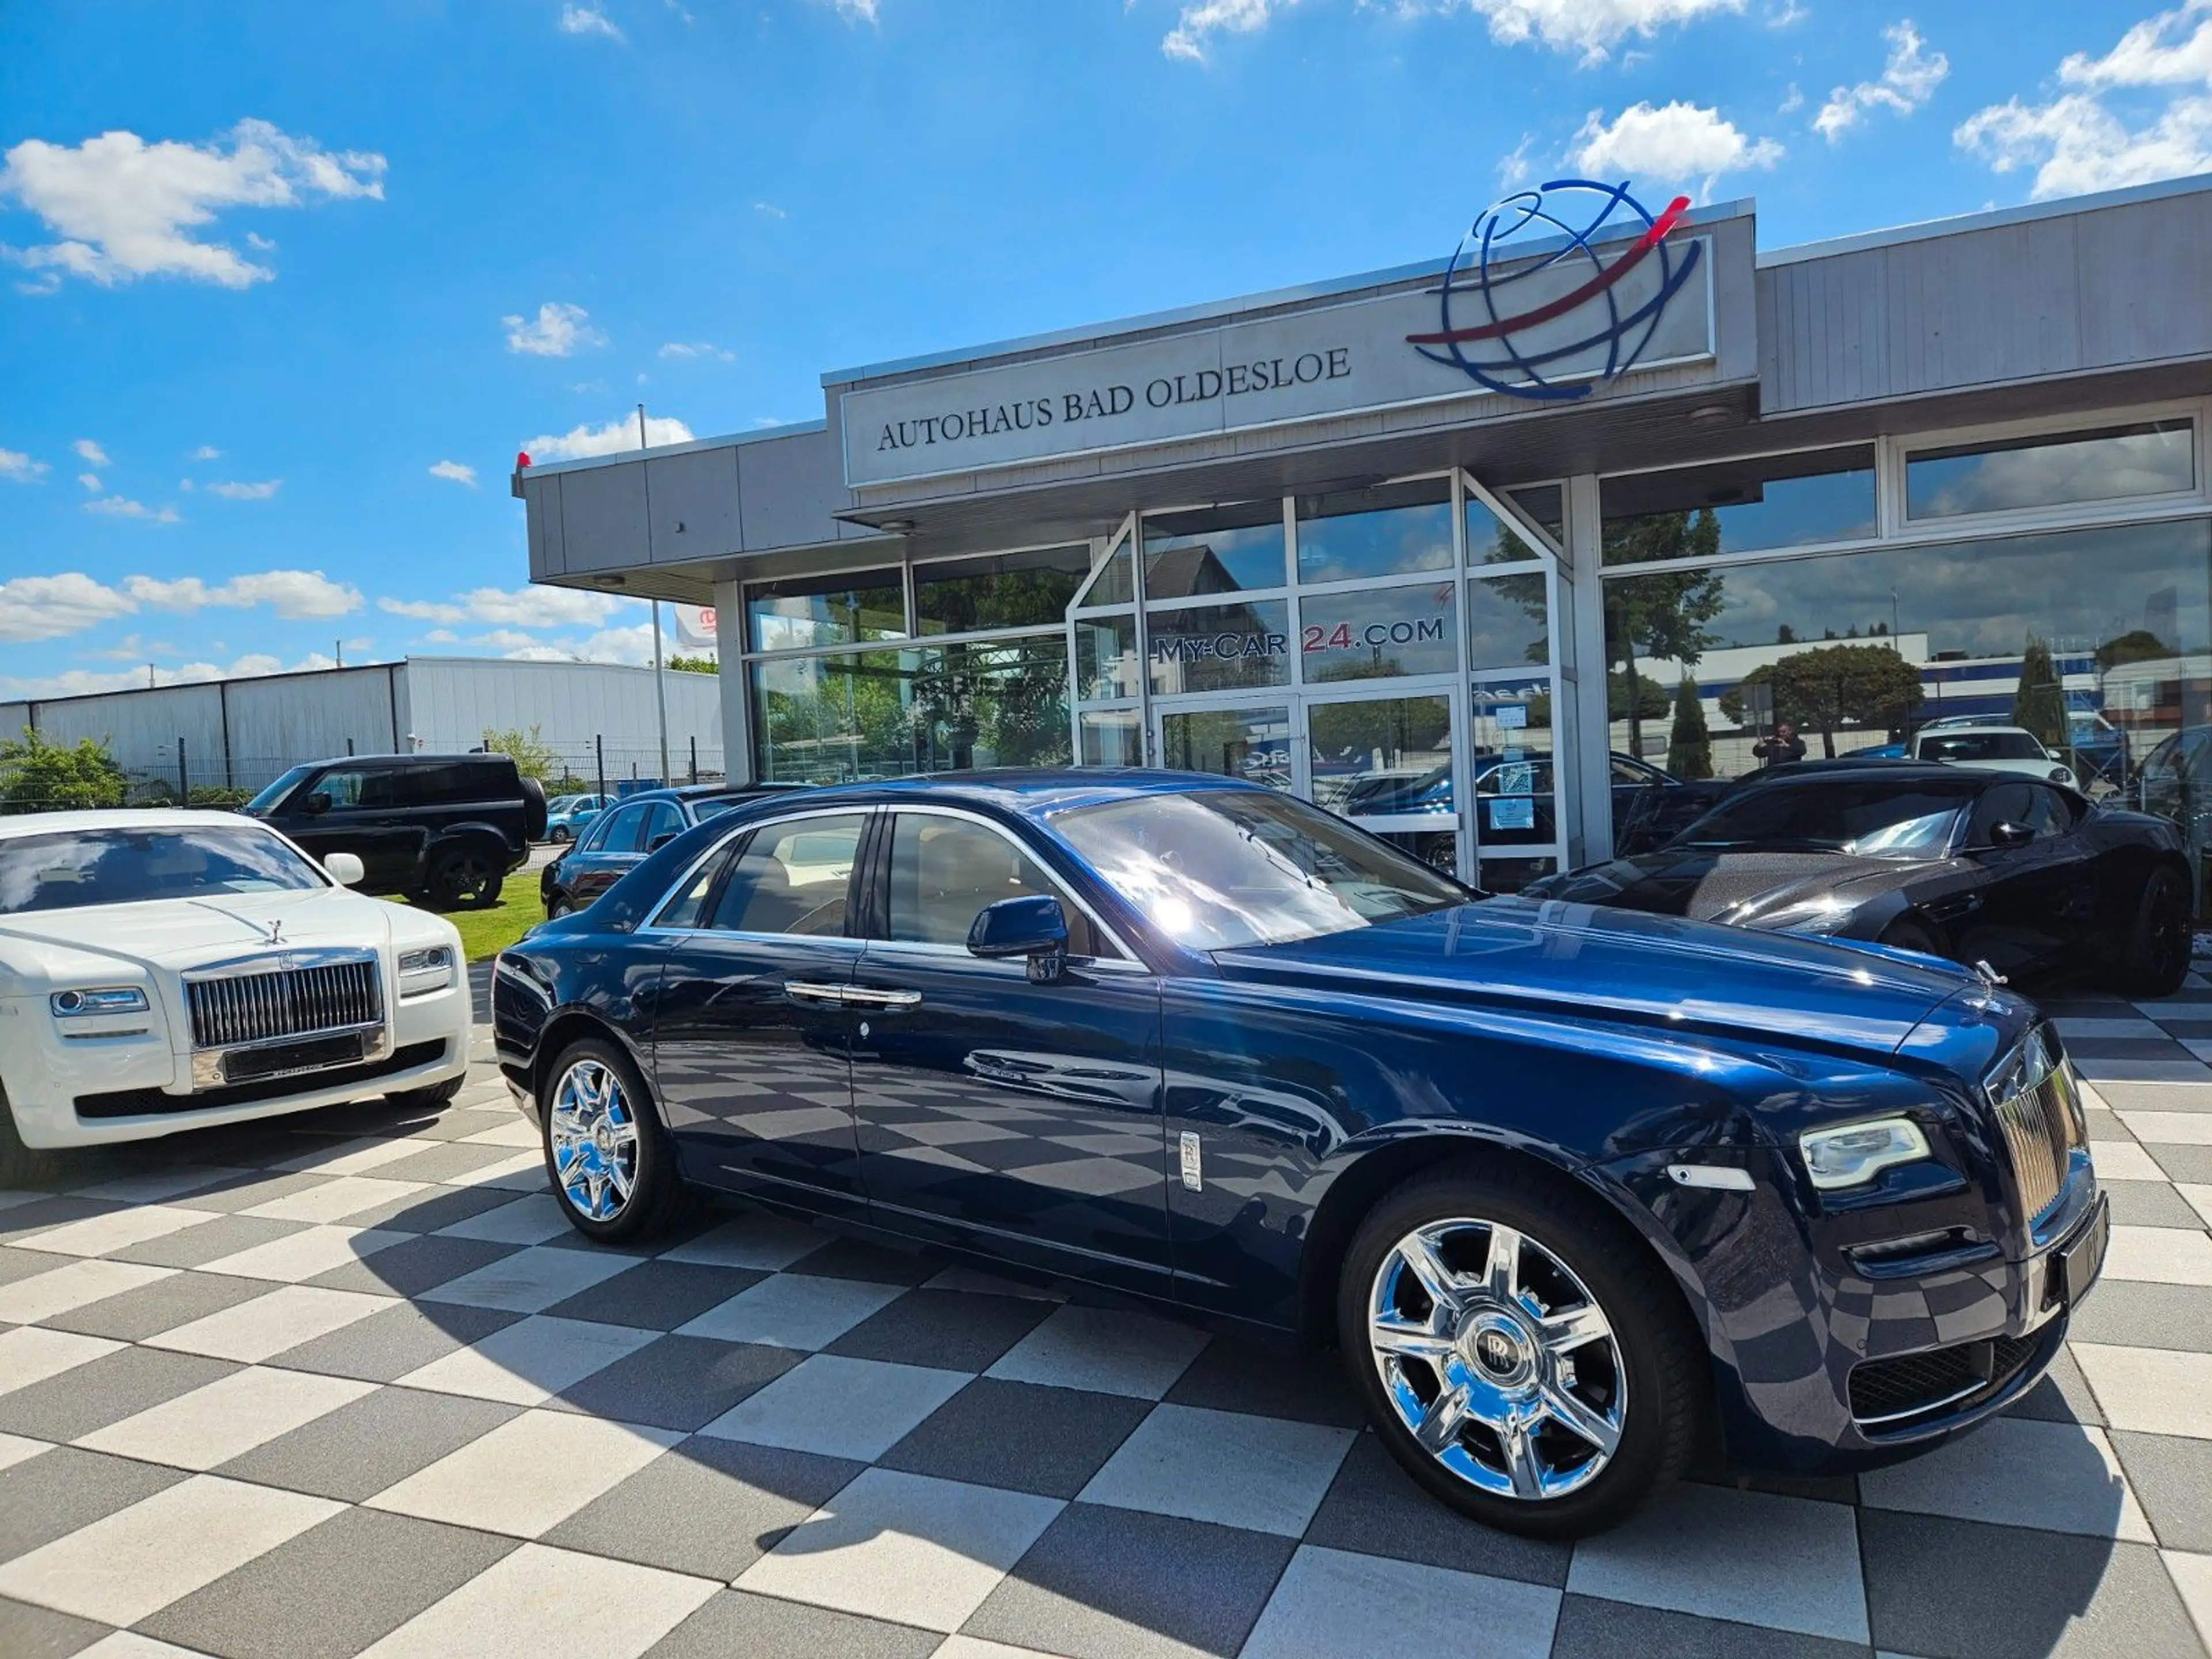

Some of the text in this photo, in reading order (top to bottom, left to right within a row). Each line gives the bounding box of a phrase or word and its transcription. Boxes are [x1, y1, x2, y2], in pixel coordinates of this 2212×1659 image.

[877, 348, 1351, 452] AUTOHAUS BAD OLDESLOE
